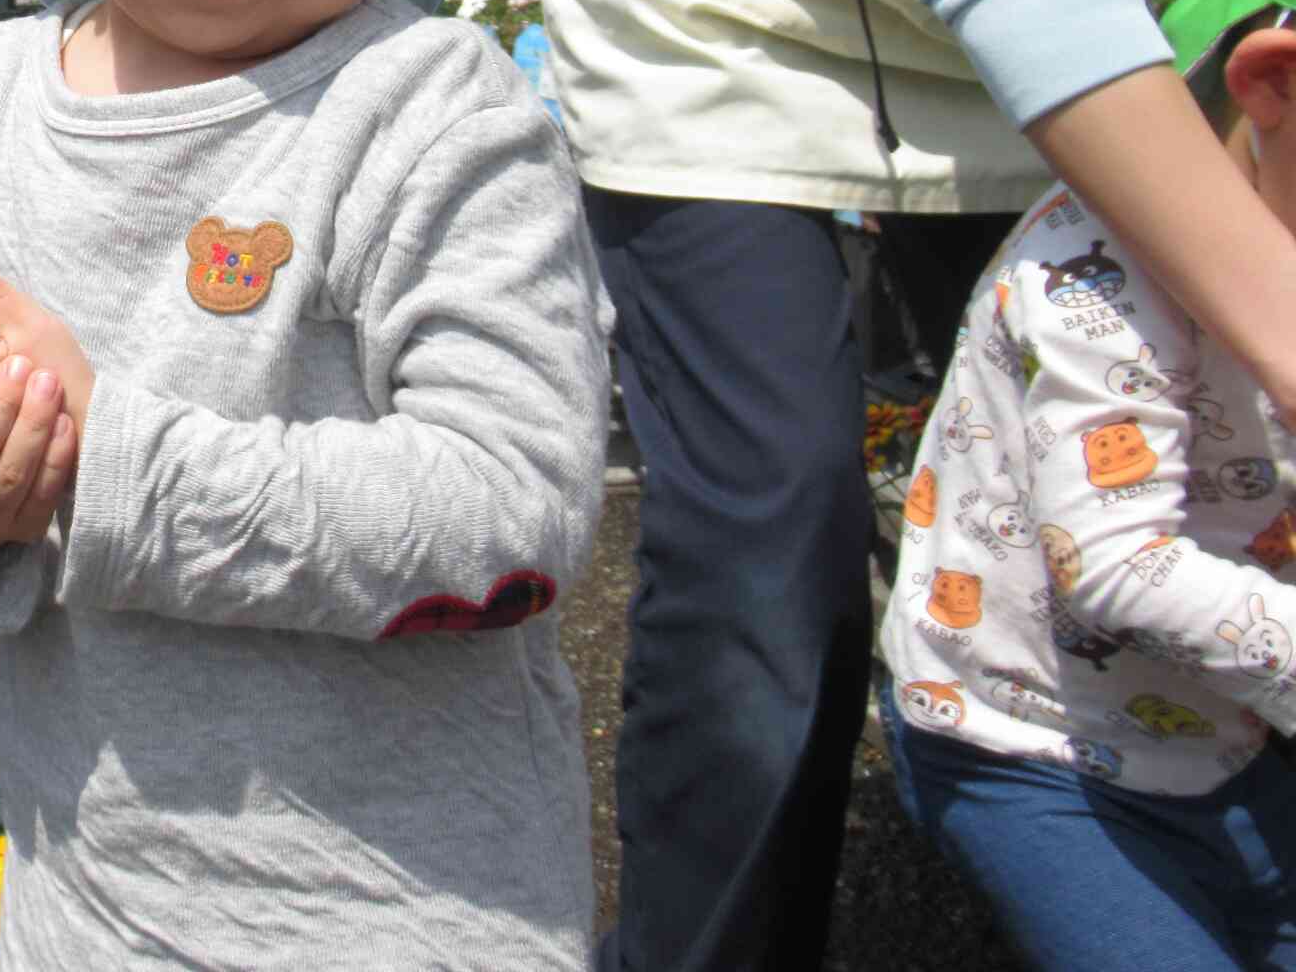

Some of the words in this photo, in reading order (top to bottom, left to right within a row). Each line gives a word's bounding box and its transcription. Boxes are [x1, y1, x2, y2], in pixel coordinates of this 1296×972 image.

[1061, 301, 1136, 331] BAIKIN
[1084, 319, 1125, 340] MAN
[1099, 479, 1160, 507] KABAO
